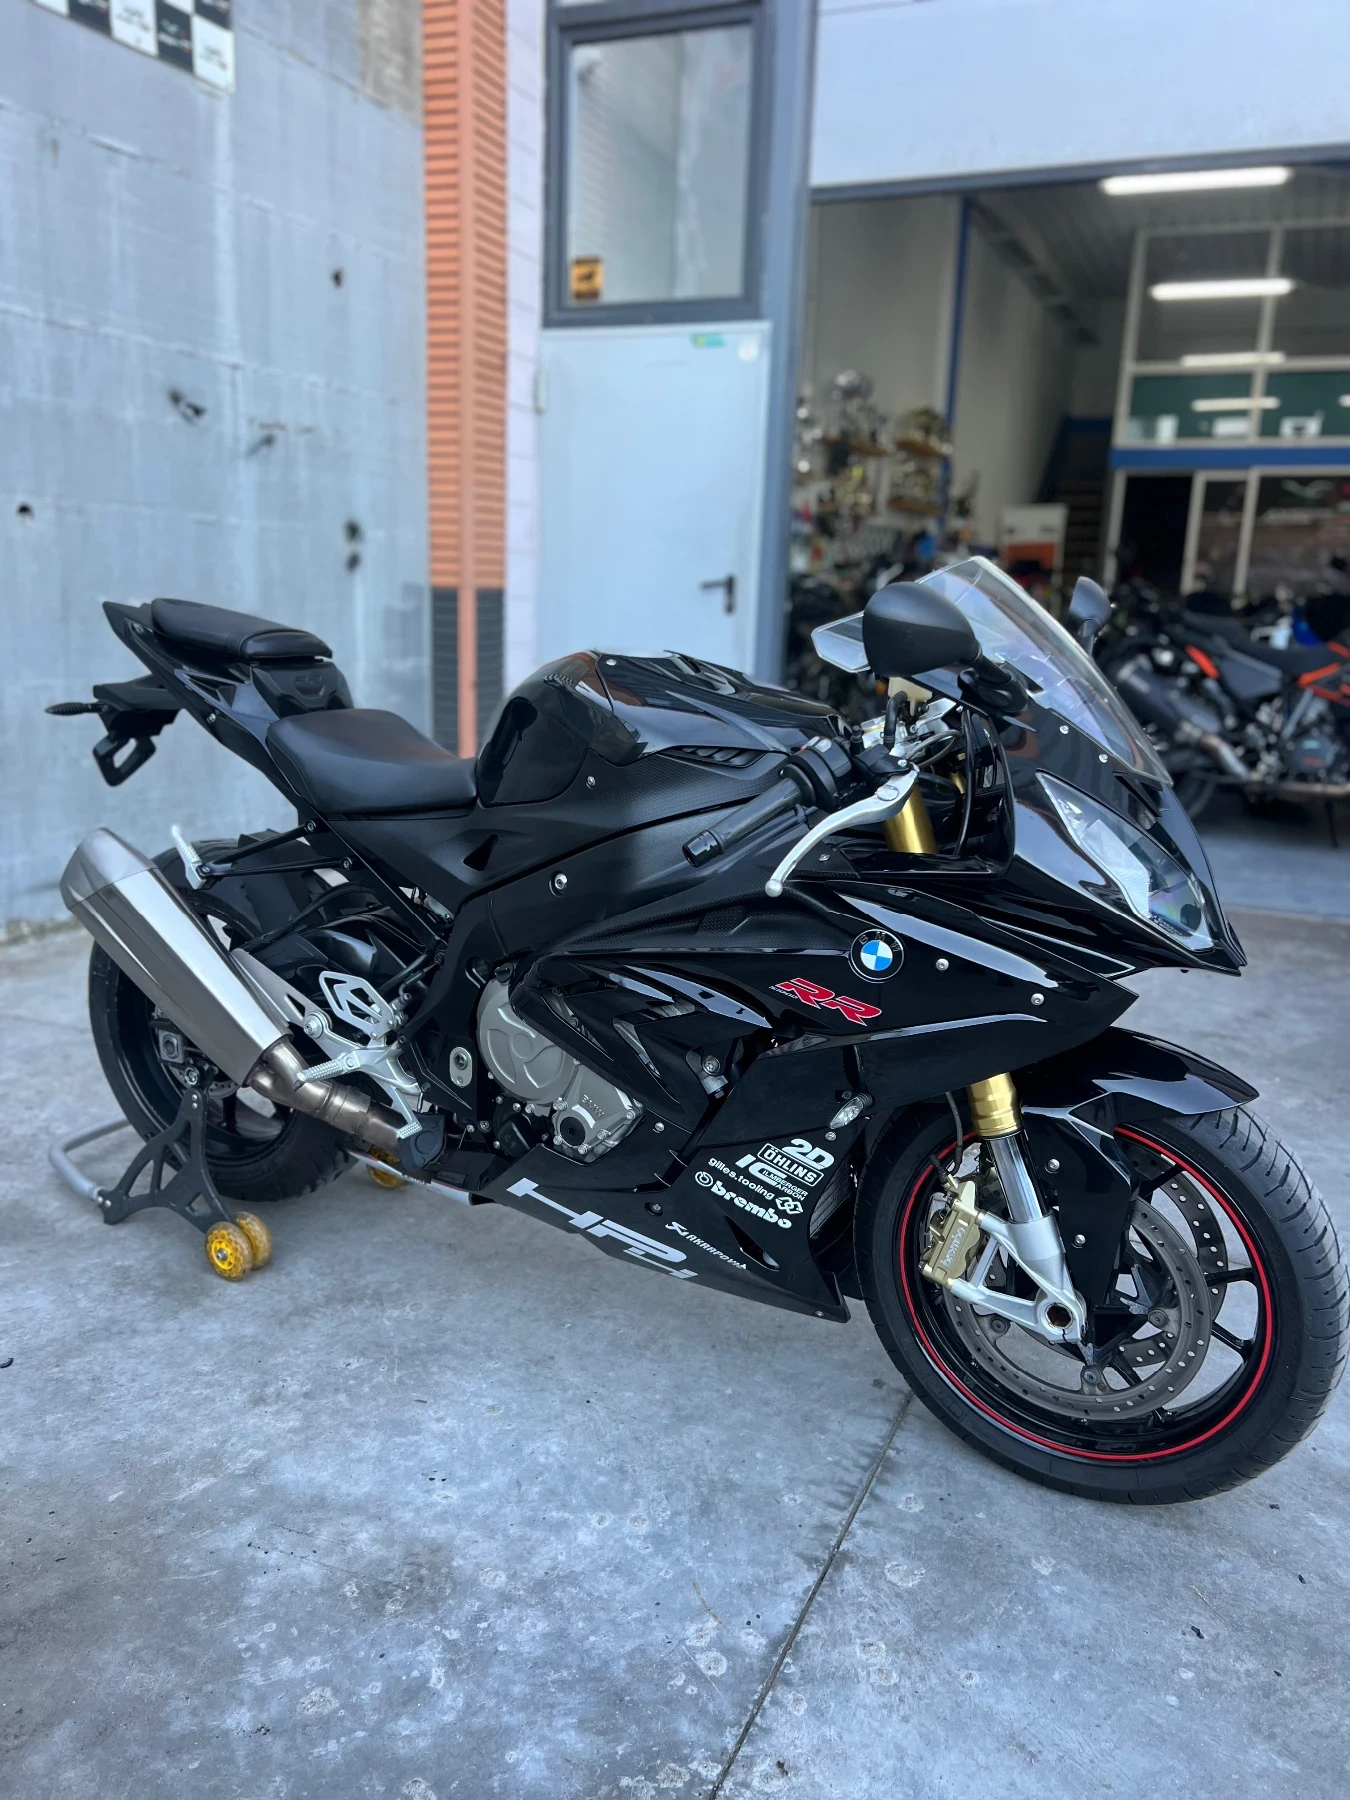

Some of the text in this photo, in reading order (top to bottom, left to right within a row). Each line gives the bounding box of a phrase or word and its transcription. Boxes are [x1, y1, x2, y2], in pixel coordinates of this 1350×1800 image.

[858, 931, 902, 952] BMW
[775, 978, 882, 1027] RR
[763, 1147, 817, 1184] ÖHLINS
[782, 1138, 835, 1170] 2D
[708, 1157, 775, 1200] gilles.tooling
[710, 1180, 792, 1229] brembo
[940, 1227, 966, 1268] brembo
